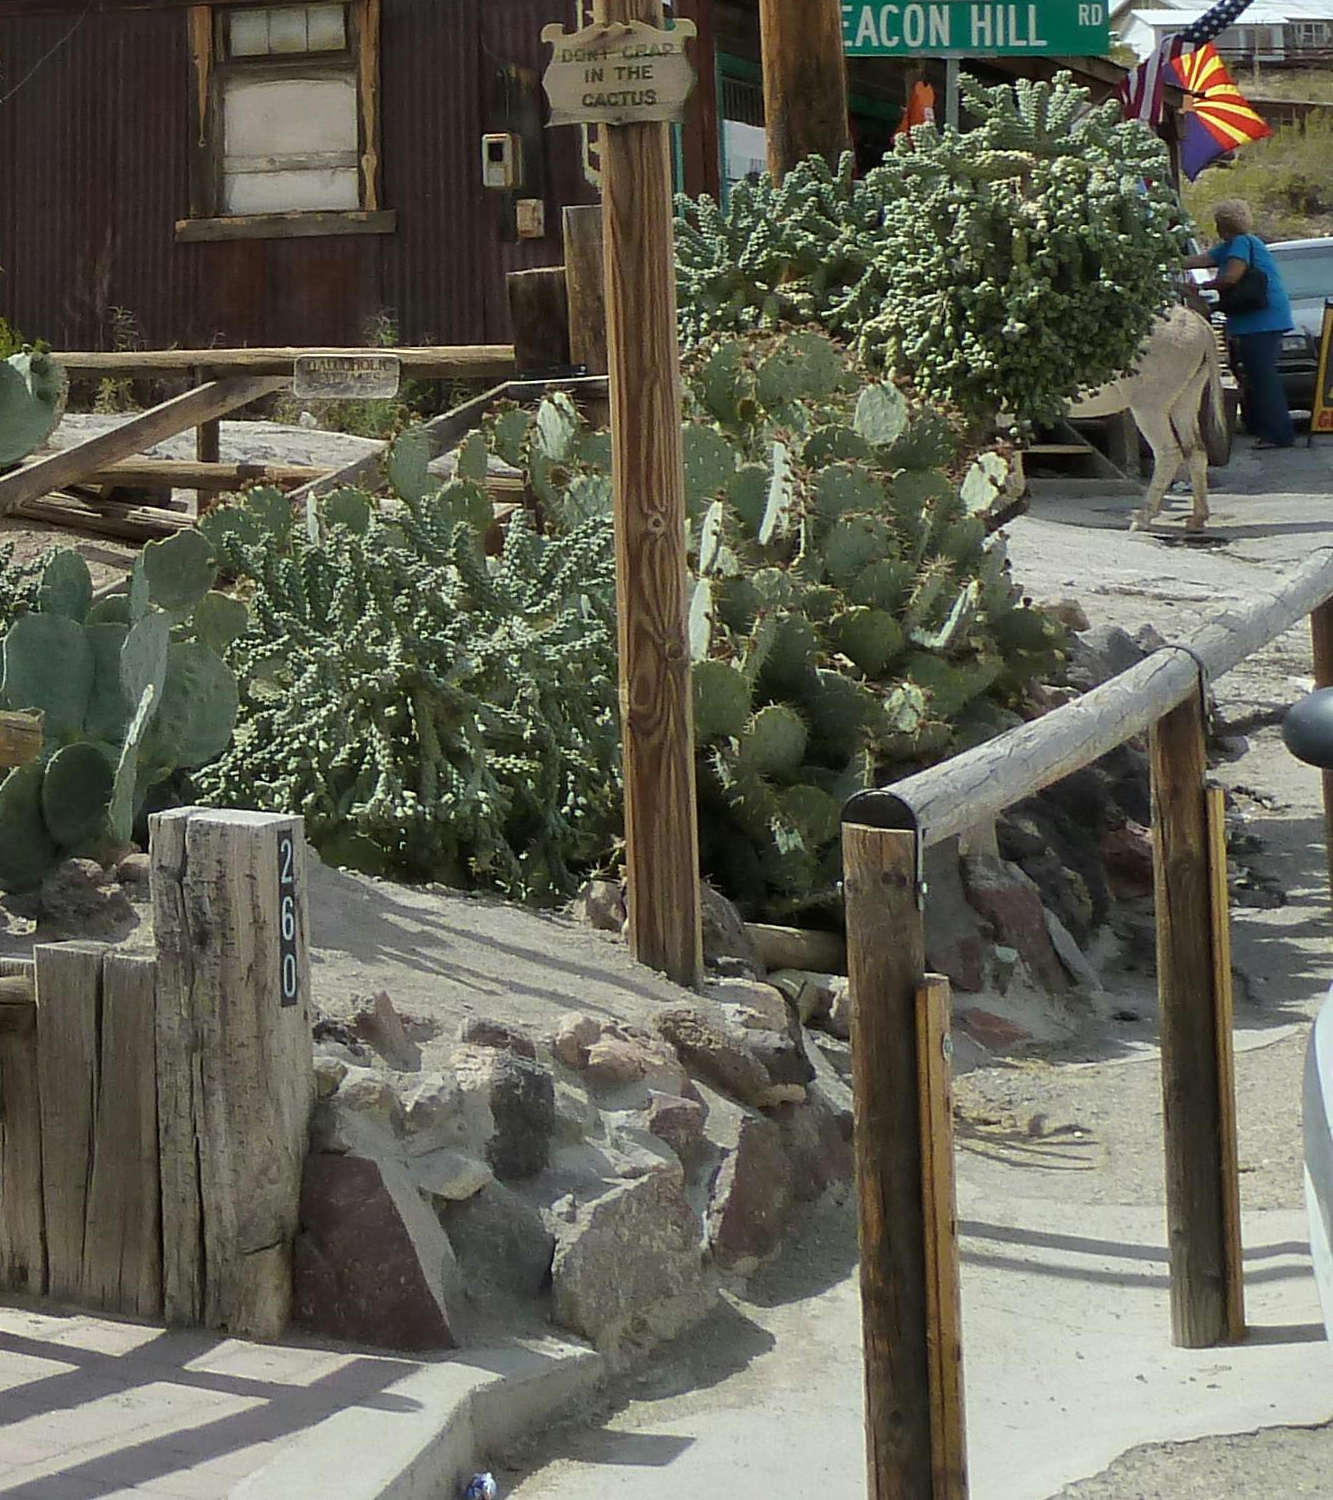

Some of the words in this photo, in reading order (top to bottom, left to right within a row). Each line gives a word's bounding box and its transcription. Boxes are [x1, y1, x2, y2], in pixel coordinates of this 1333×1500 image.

[841, 4, 950, 48] EACON
[971, 4, 1049, 47] HILL
[1078, 3, 1103, 26] RD
[584, 67, 604, 83] IN
[614, 64, 654, 81] THE
[582, 88, 658, 108] CACTUS
[280, 838, 296, 998] 260
